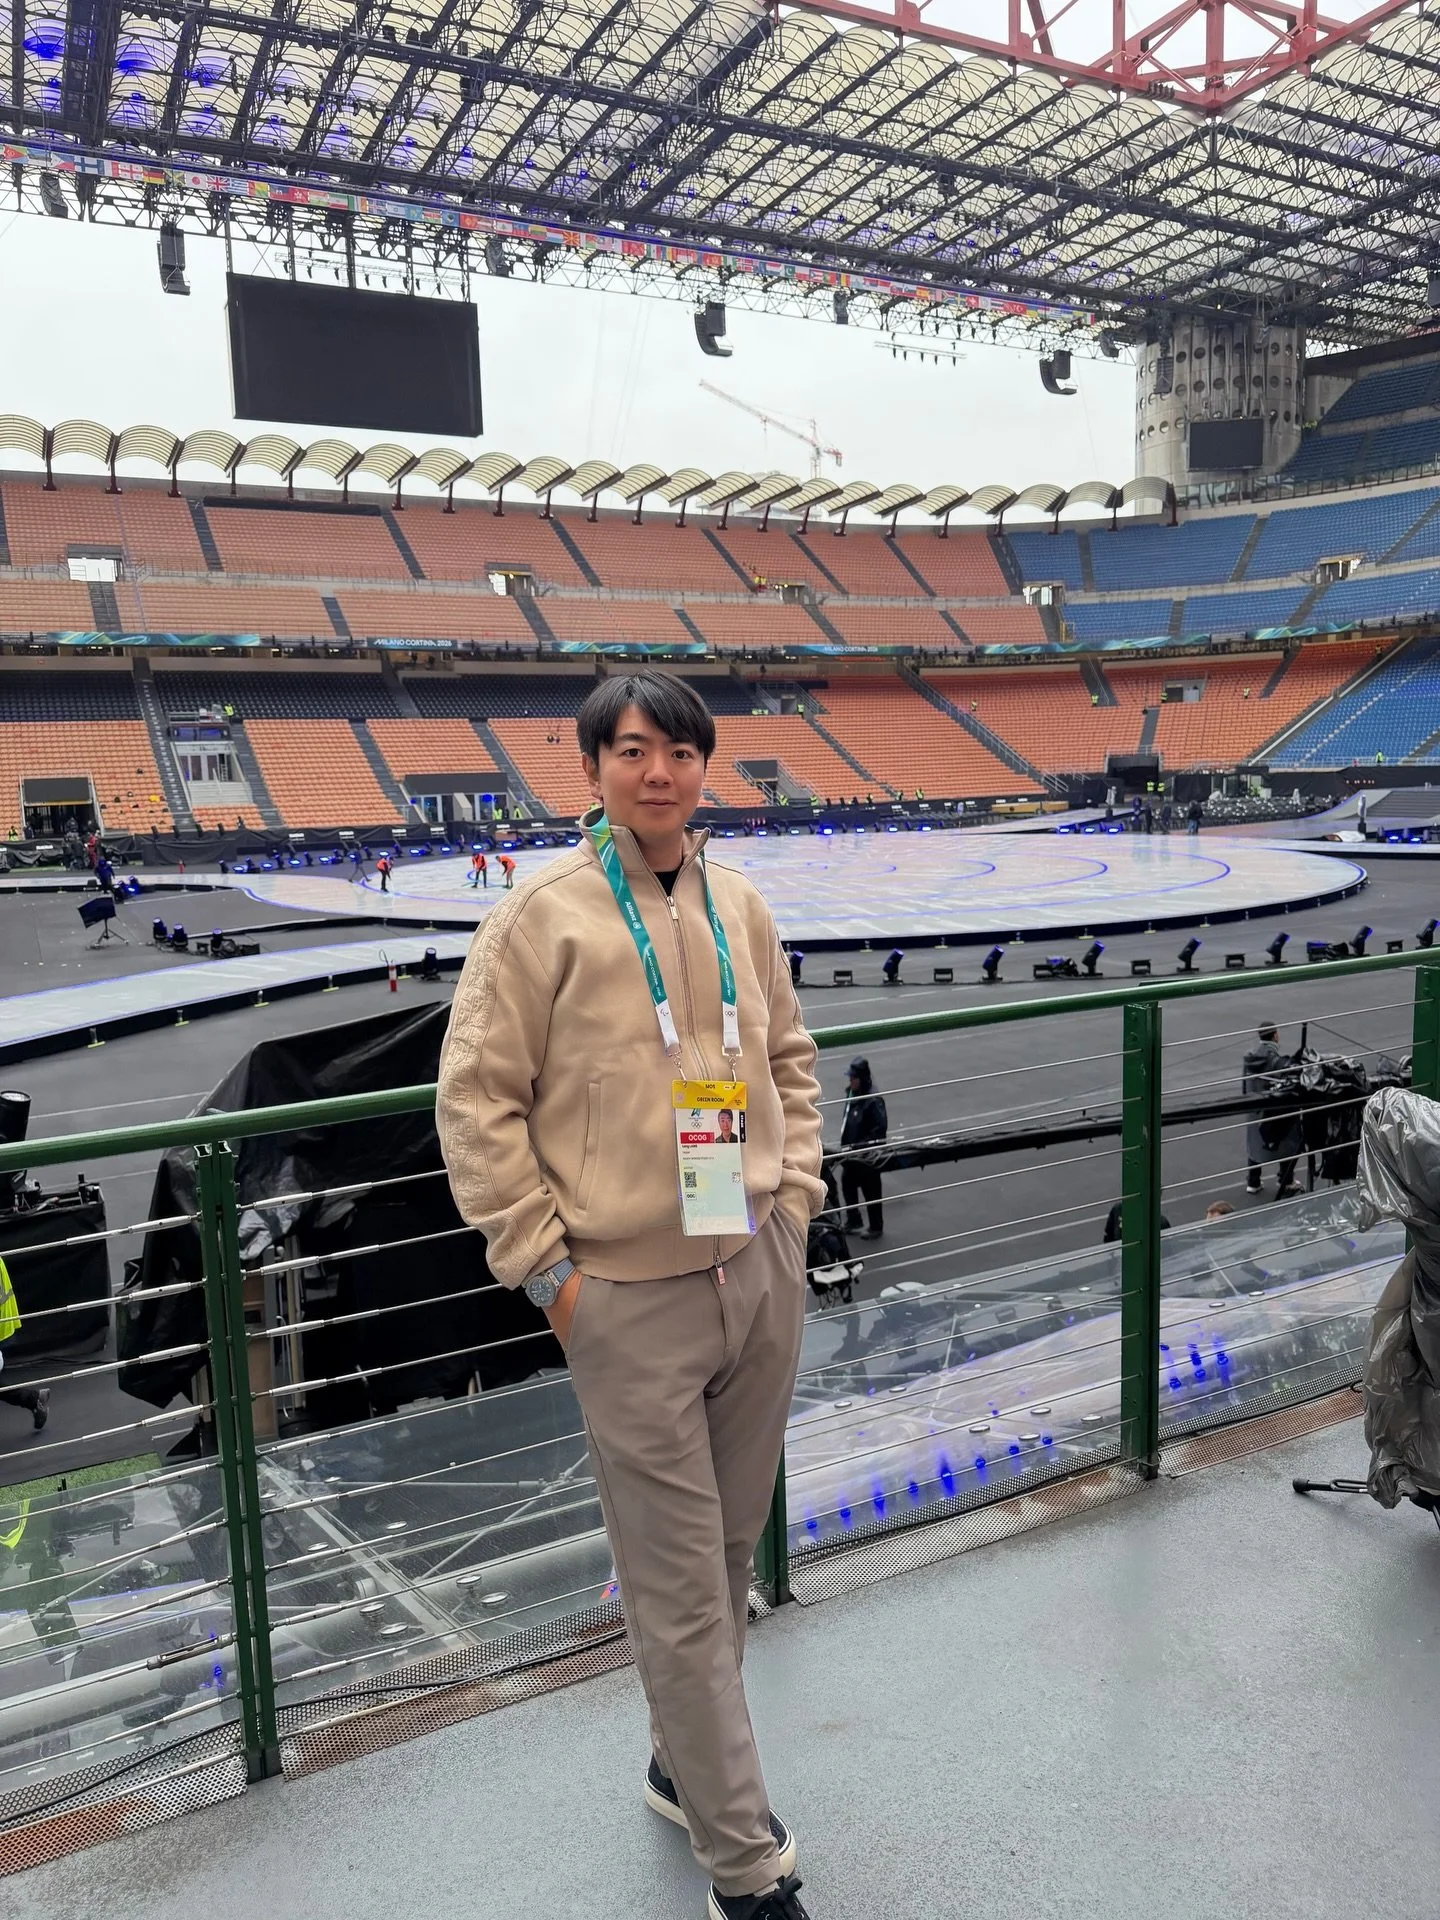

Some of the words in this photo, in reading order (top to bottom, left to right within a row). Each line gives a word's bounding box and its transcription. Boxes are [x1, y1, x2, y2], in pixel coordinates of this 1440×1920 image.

[374, 639, 404, 647] MILANO
[405, 639, 437, 647] CORTINA
[437, 639, 452, 647] 2026
[625, 901, 637, 921] Allianz
